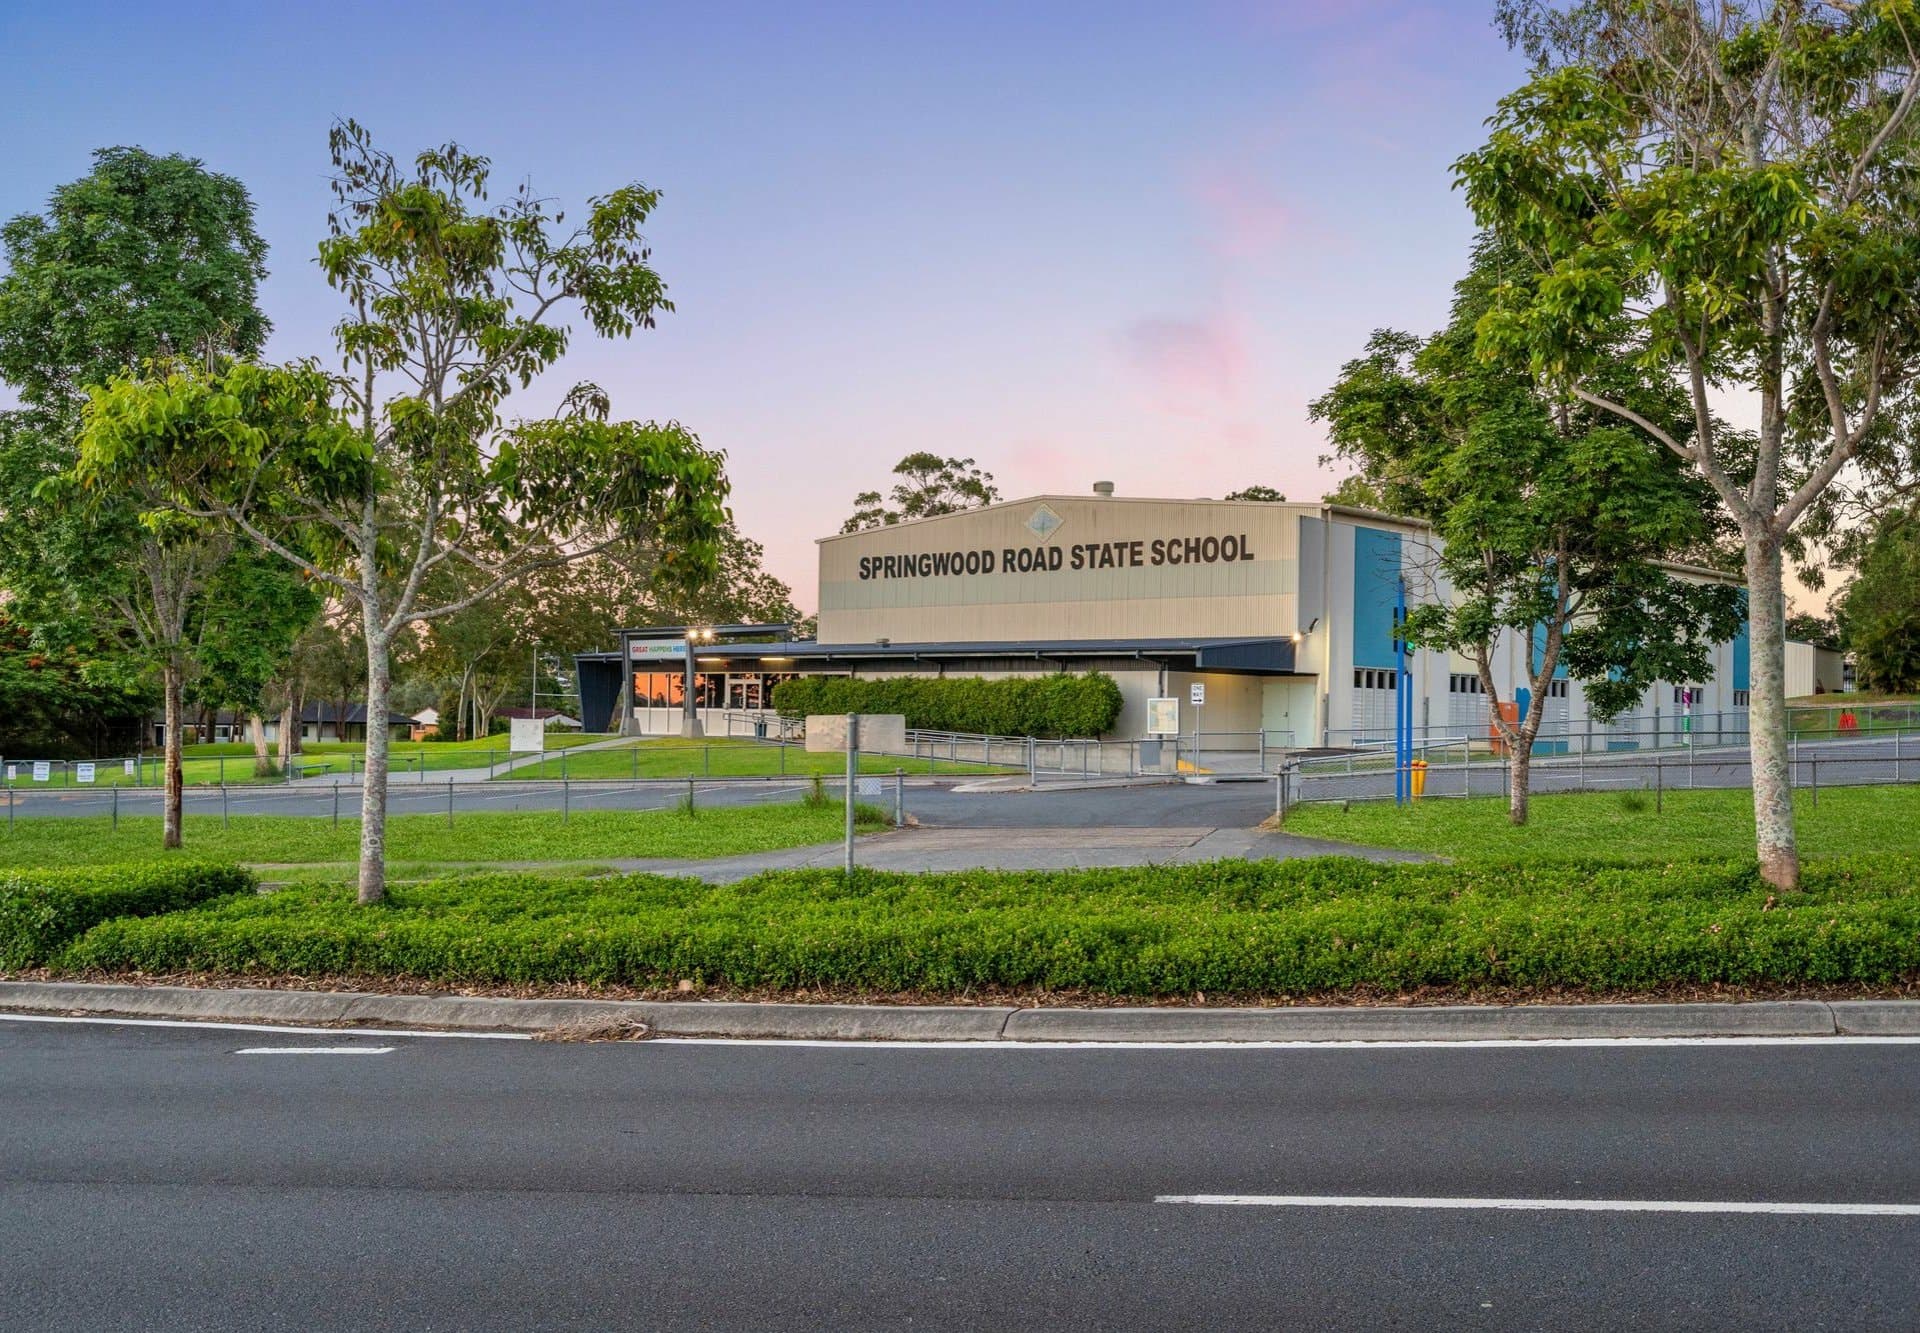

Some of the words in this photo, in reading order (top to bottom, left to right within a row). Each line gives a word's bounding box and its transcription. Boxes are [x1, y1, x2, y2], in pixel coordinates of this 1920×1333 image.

[859, 549, 995, 580] SPRINGWOOD
[1002, 546, 1064, 573] ROAD
[1070, 541, 1145, 570] STATE
[1150, 534, 1255, 566] SCHOOL
